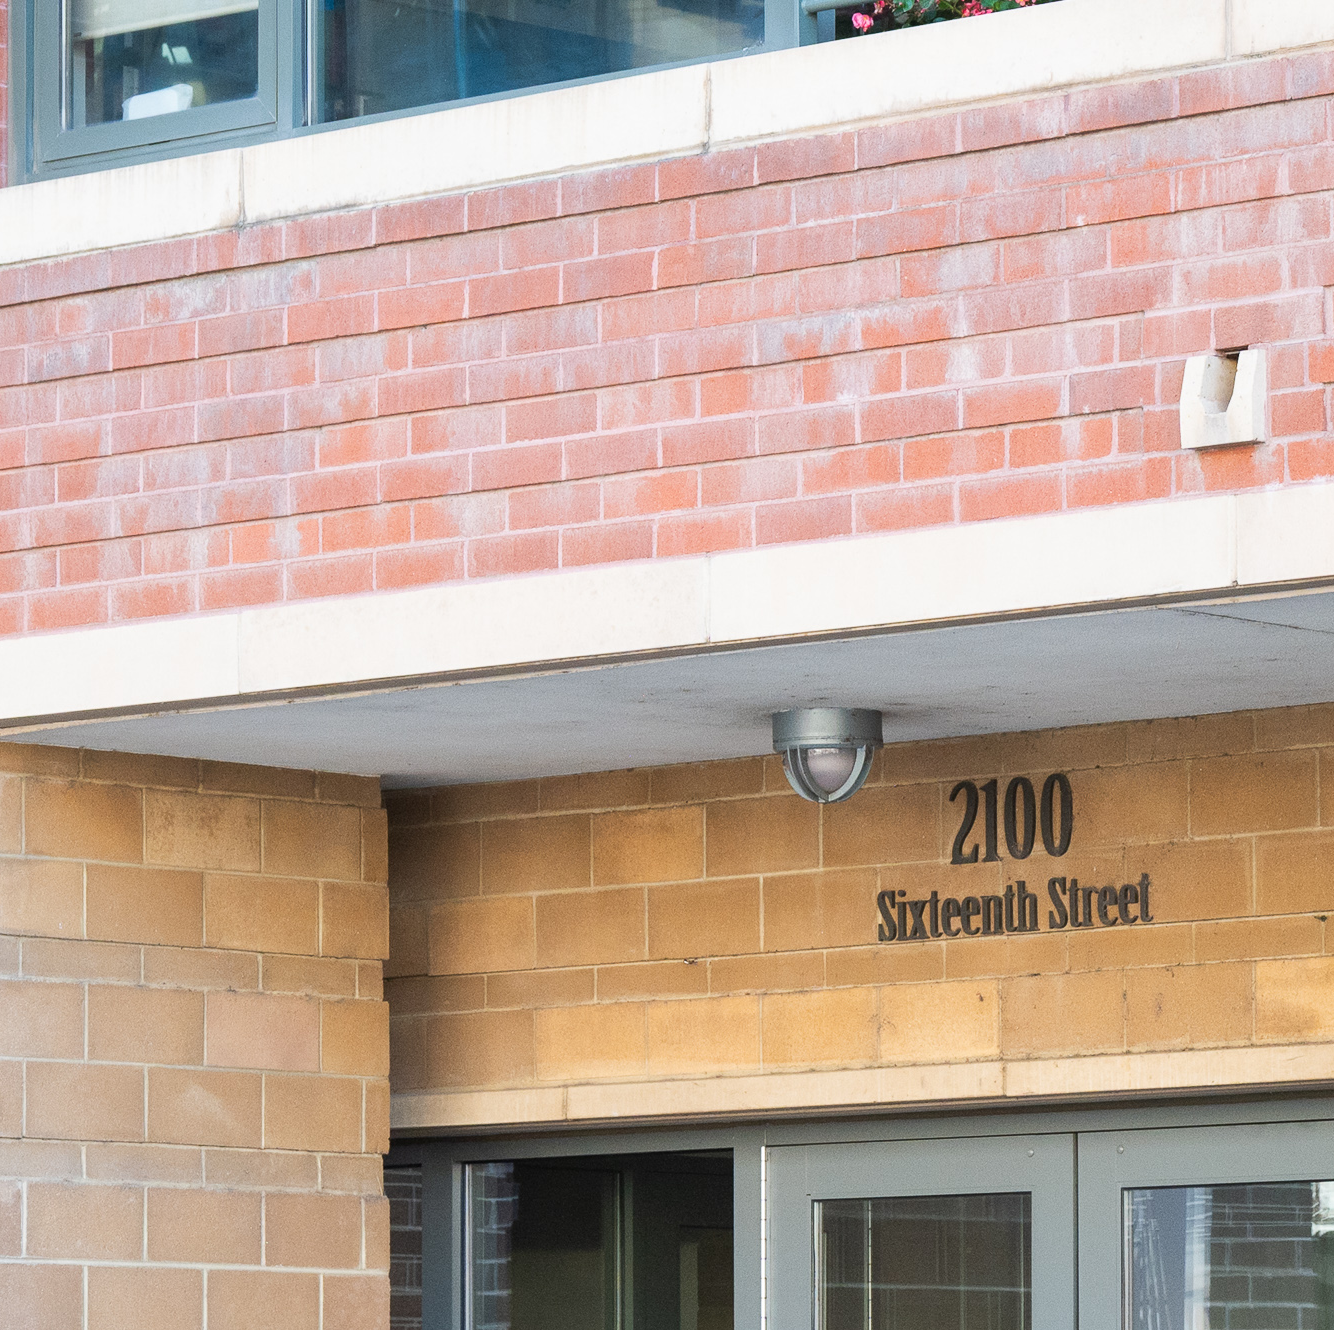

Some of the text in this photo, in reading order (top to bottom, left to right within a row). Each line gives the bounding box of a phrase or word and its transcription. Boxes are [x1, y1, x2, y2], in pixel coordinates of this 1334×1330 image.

[950, 773, 1073, 865] 2100
[877, 872, 1154, 942] Sixteenth Street
